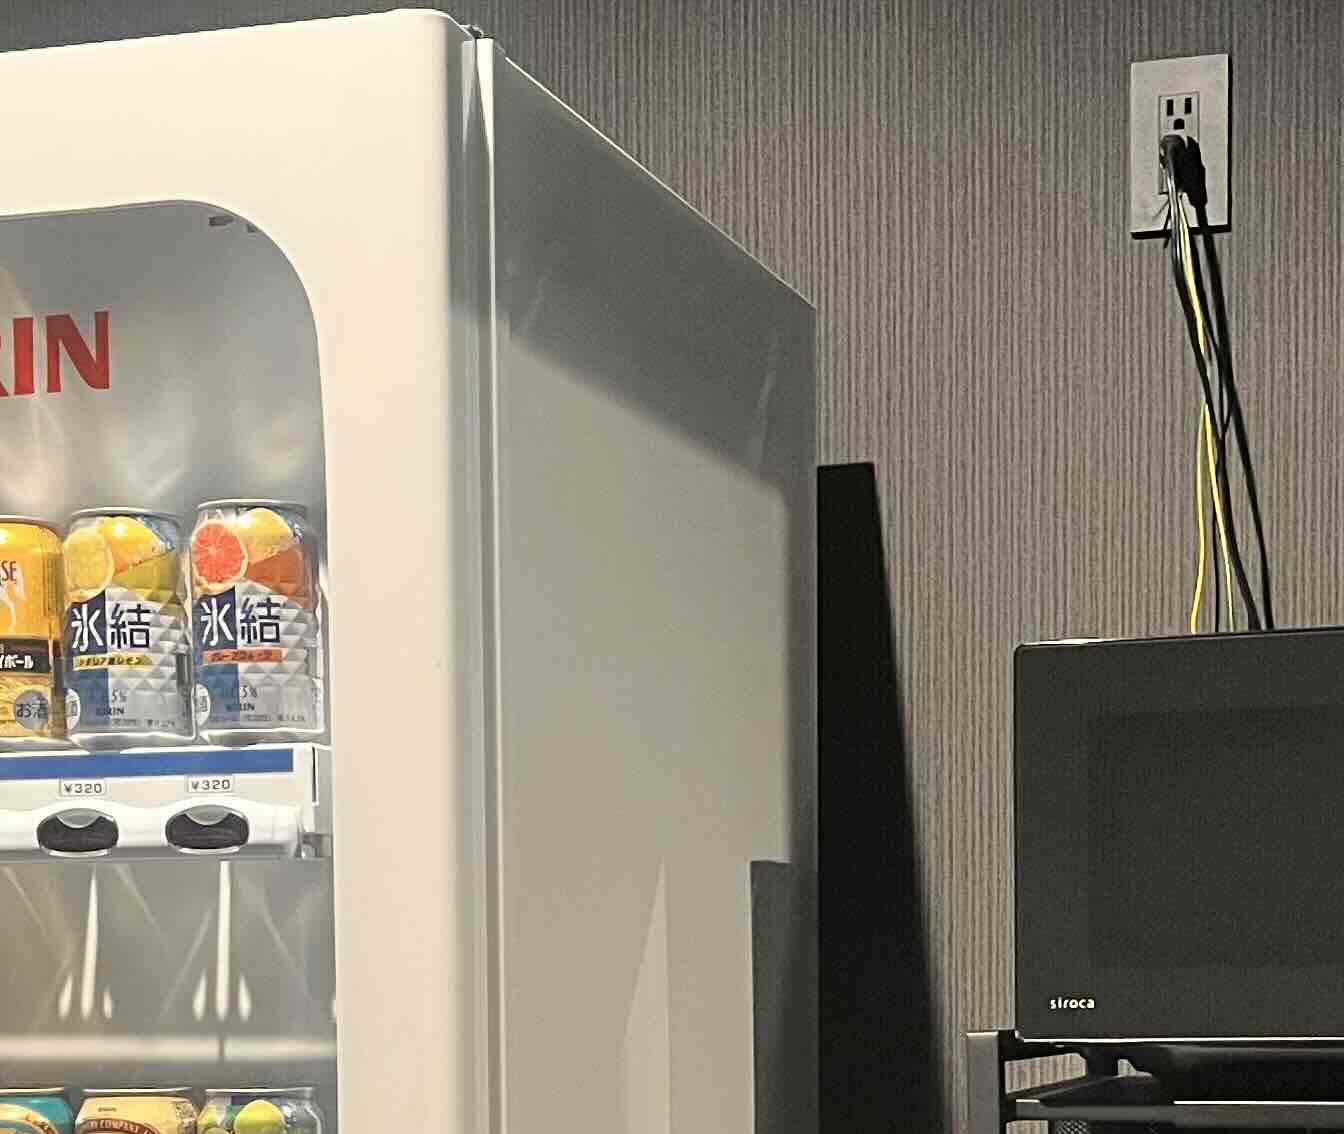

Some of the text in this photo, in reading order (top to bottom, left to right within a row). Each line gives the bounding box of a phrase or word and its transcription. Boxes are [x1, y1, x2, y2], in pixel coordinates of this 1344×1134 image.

[71, 603, 151, 652] 氷結
[201, 597, 281, 647] 氷結
[64, 783, 102, 794] ¥320
[191, 779, 231, 791] ¥320
[1049, 996, 1095, 1009] siroca
